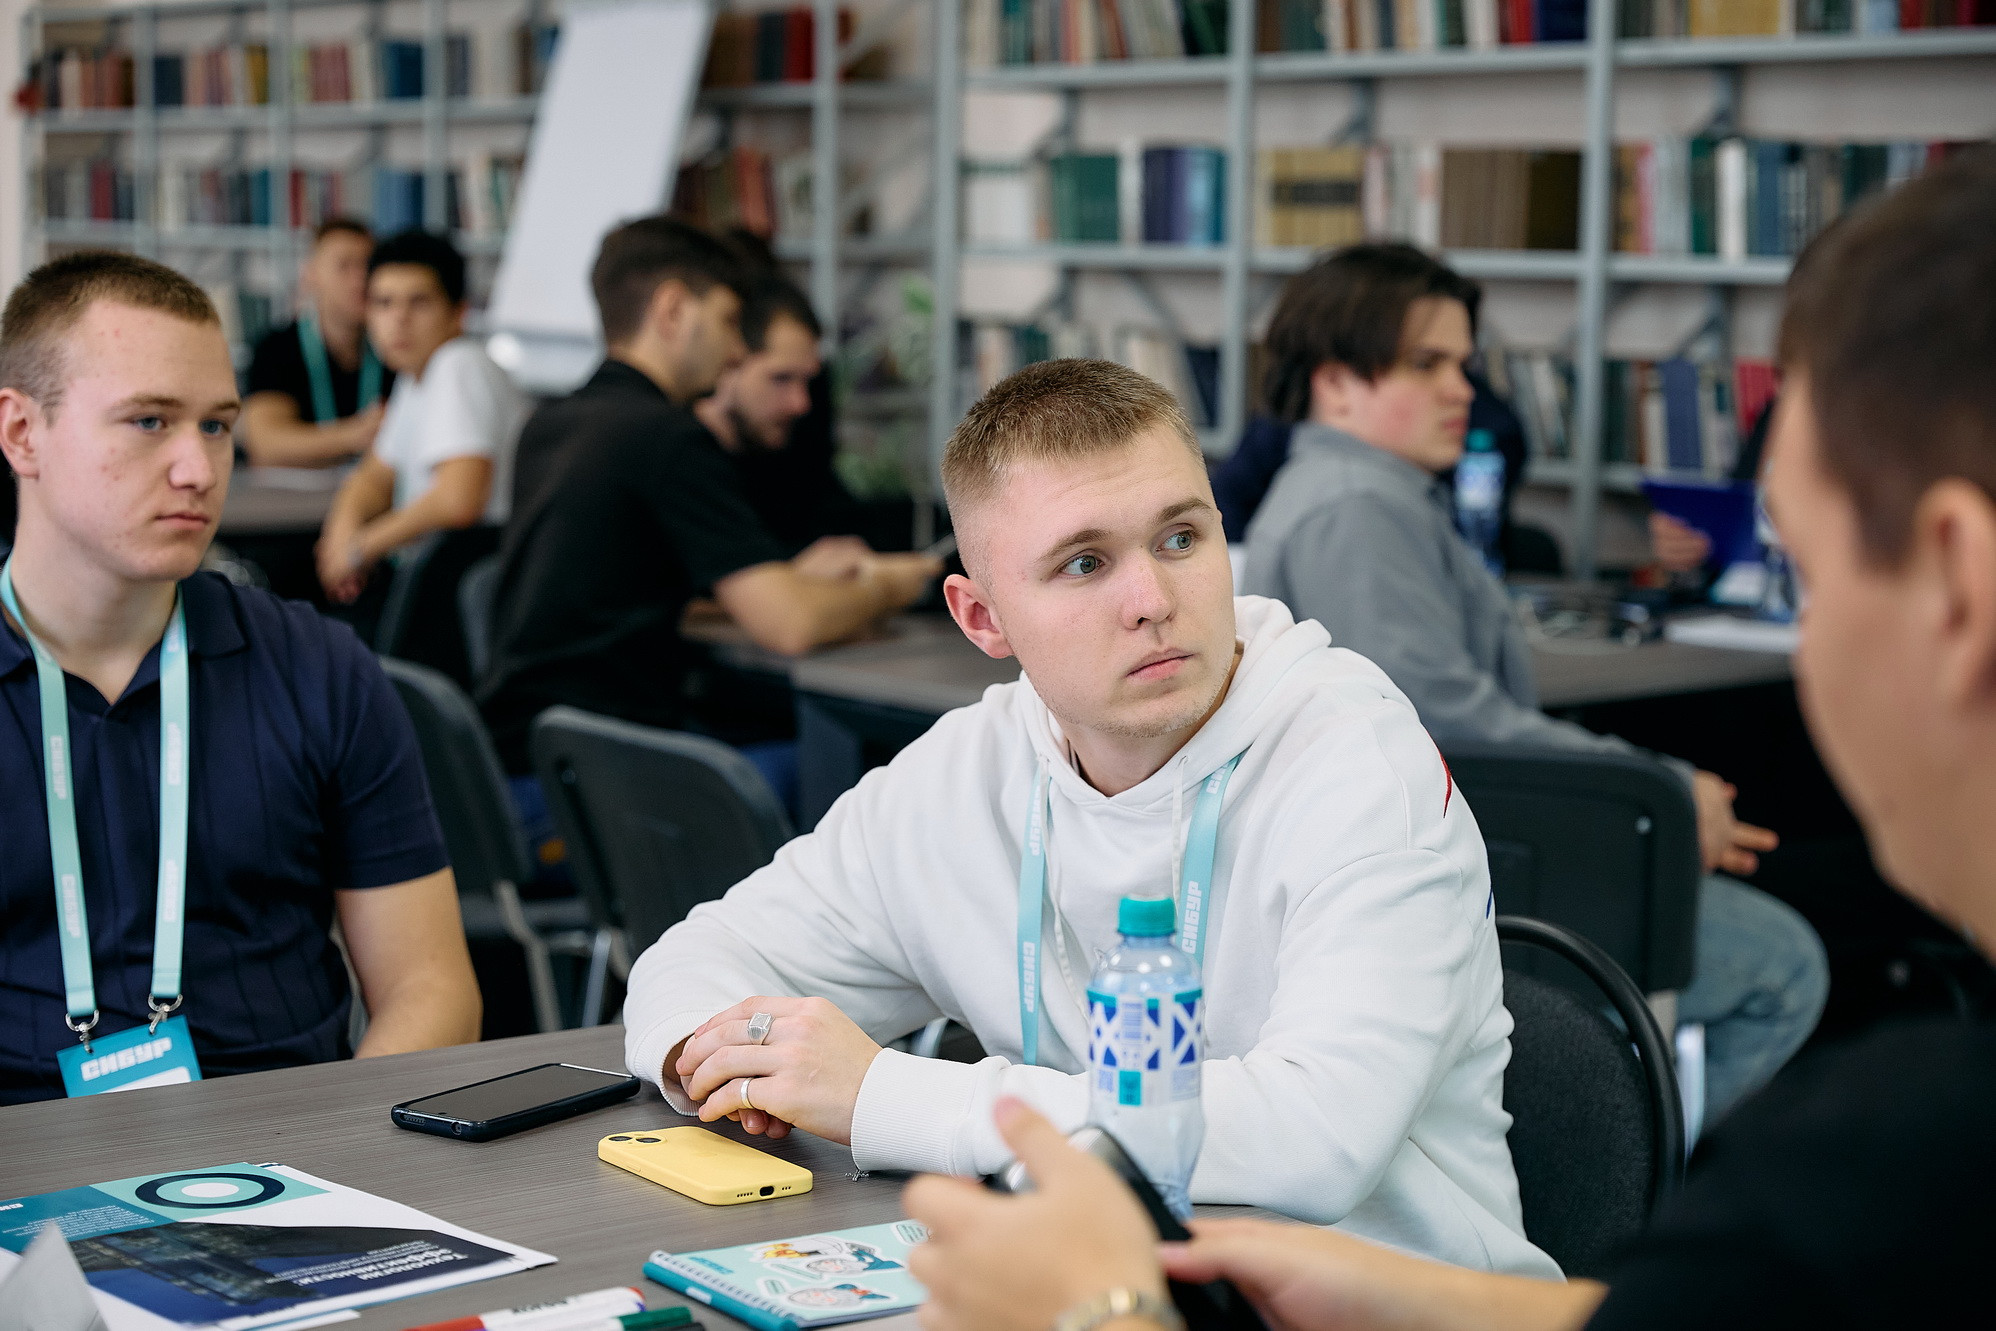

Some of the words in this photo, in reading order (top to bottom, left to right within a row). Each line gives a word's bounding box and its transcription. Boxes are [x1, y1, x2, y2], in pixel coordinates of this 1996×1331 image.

[1181, 880, 1203, 955] СИБУР
[1022, 941, 1036, 1013] СИБУР
[80, 1036, 173, 1082] СИБУР
[358, 1253, 469, 1281] Технологии
